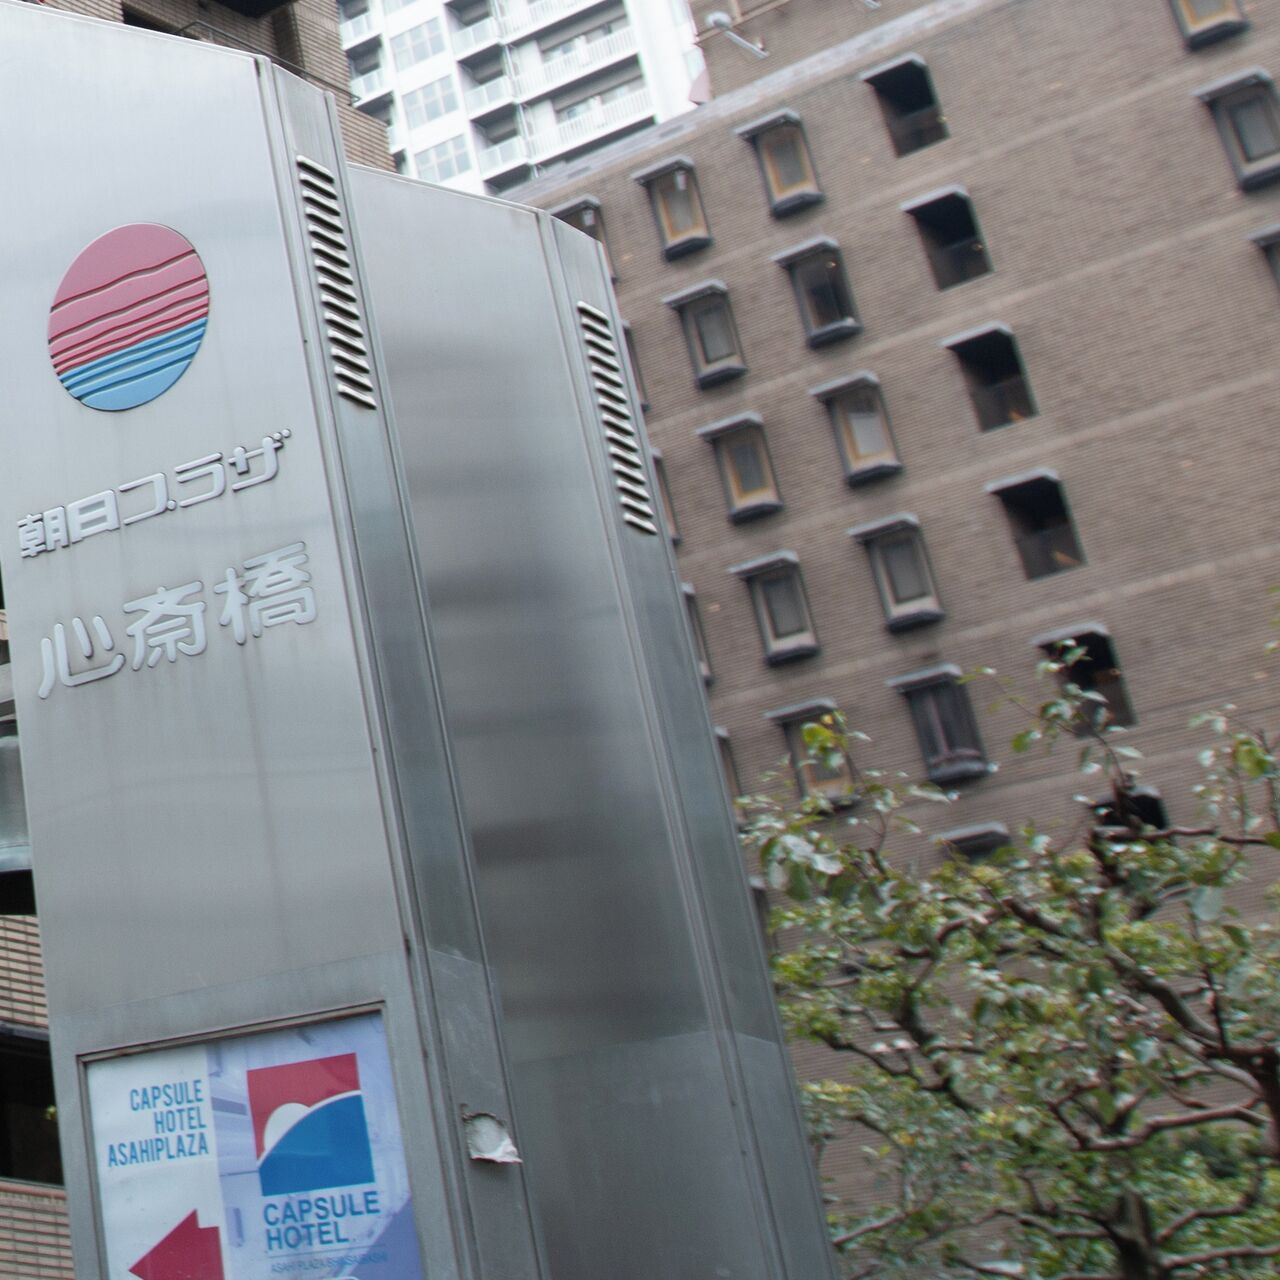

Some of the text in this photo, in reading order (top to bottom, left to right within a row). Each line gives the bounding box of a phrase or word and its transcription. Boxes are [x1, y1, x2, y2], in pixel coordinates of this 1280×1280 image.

[17, 428, 292, 558] 朝日プラザ
[38, 541, 318, 699] 心斎橋
[129, 1079, 205, 1111] CAPSULE
[153, 1106, 207, 1134] HOTEL
[108, 1132, 209, 1167] ASAHIPLAZA
[263, 1191, 380, 1226] CAPSULE
[266, 1221, 349, 1251] HOTEL
